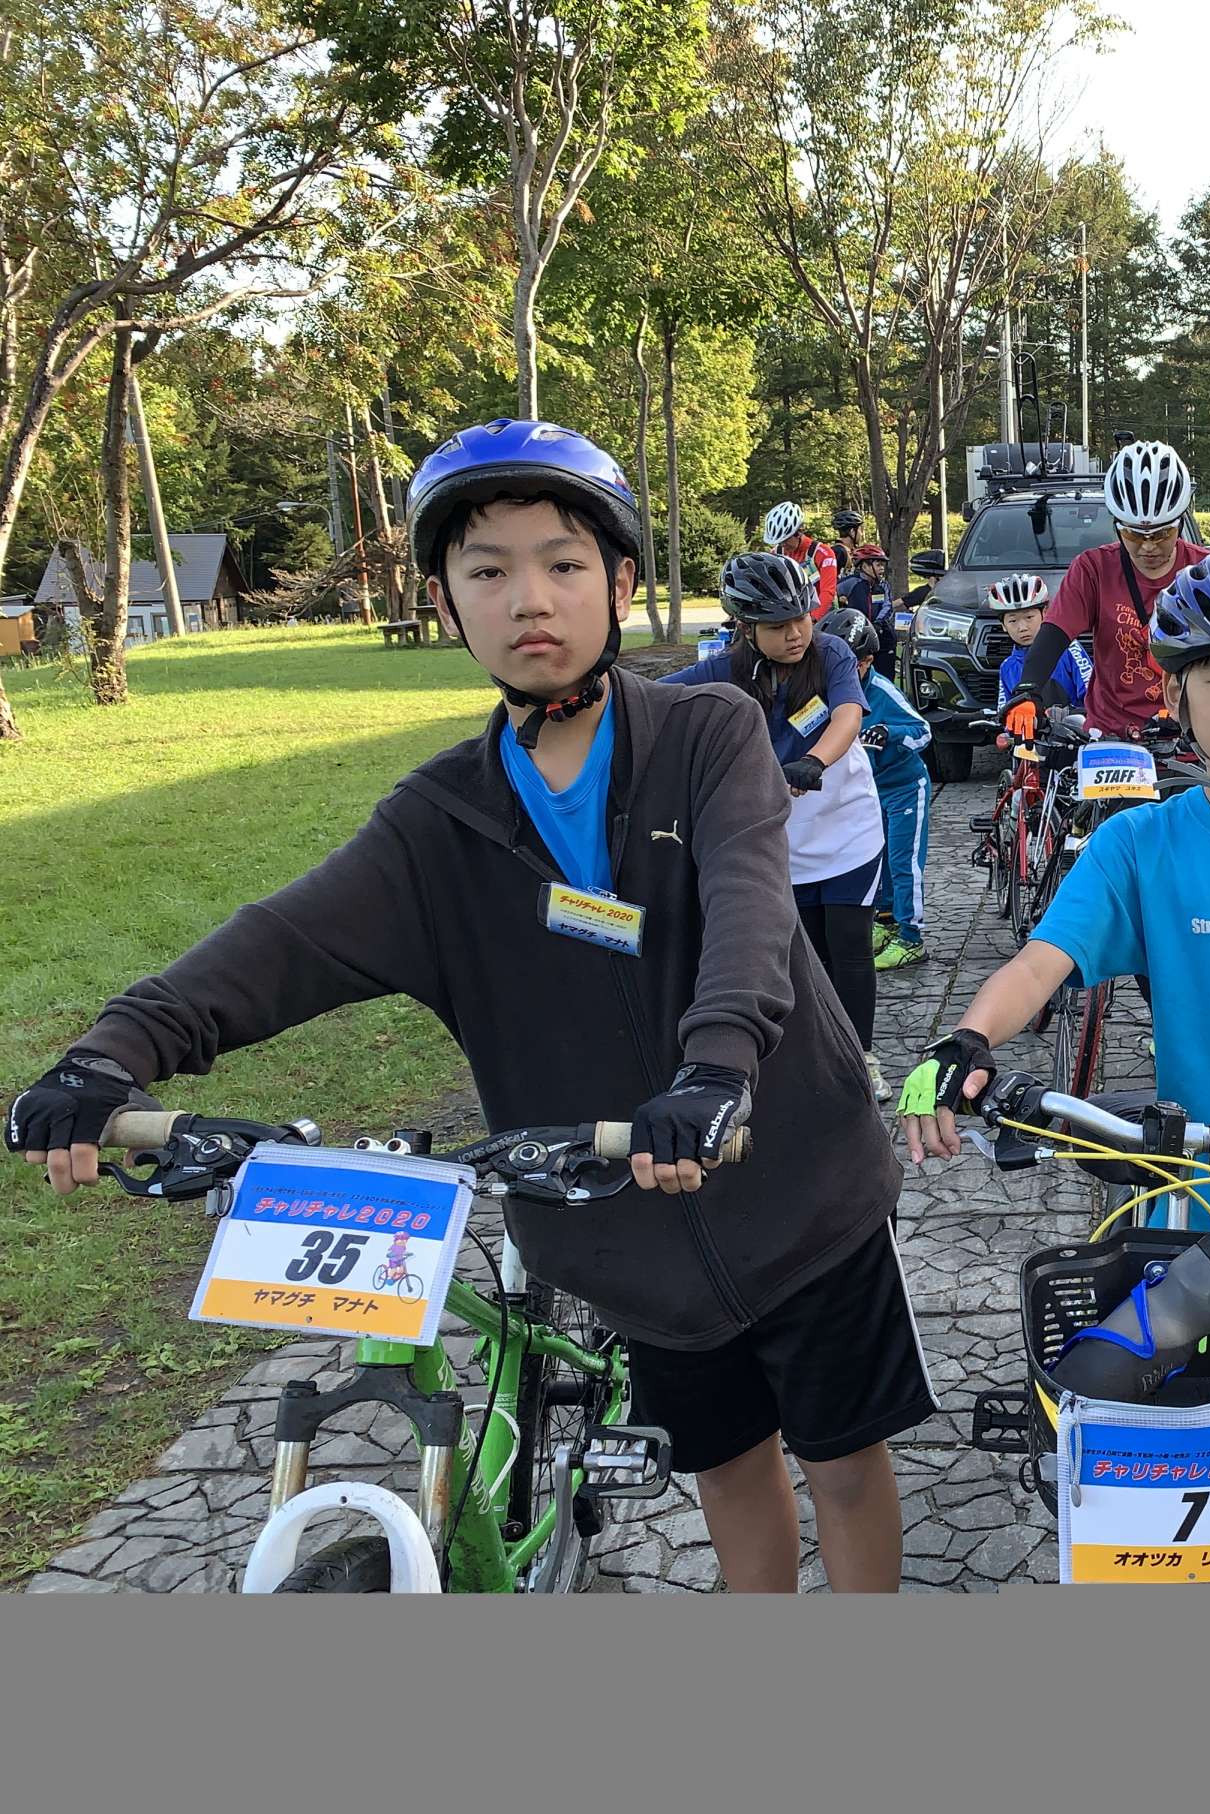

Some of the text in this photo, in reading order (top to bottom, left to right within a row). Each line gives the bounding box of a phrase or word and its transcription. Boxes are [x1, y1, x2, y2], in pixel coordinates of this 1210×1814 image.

[1094, 769, 1136, 784] STAFF
[560, 895, 606, 913] チャリチャレ
[606, 909, 634, 922] 2020
[559, 922, 630, 948] ヤマグチ マナト
[254, 1197, 431, 1231] チャリチャレ2020
[285, 1230, 371, 1285] 35
[253, 1288, 379, 1315] ヤマグチ マナト
[1172, 1491, 1210, 1543] 7
[1113, 1551, 1184, 1567] オオツカ
